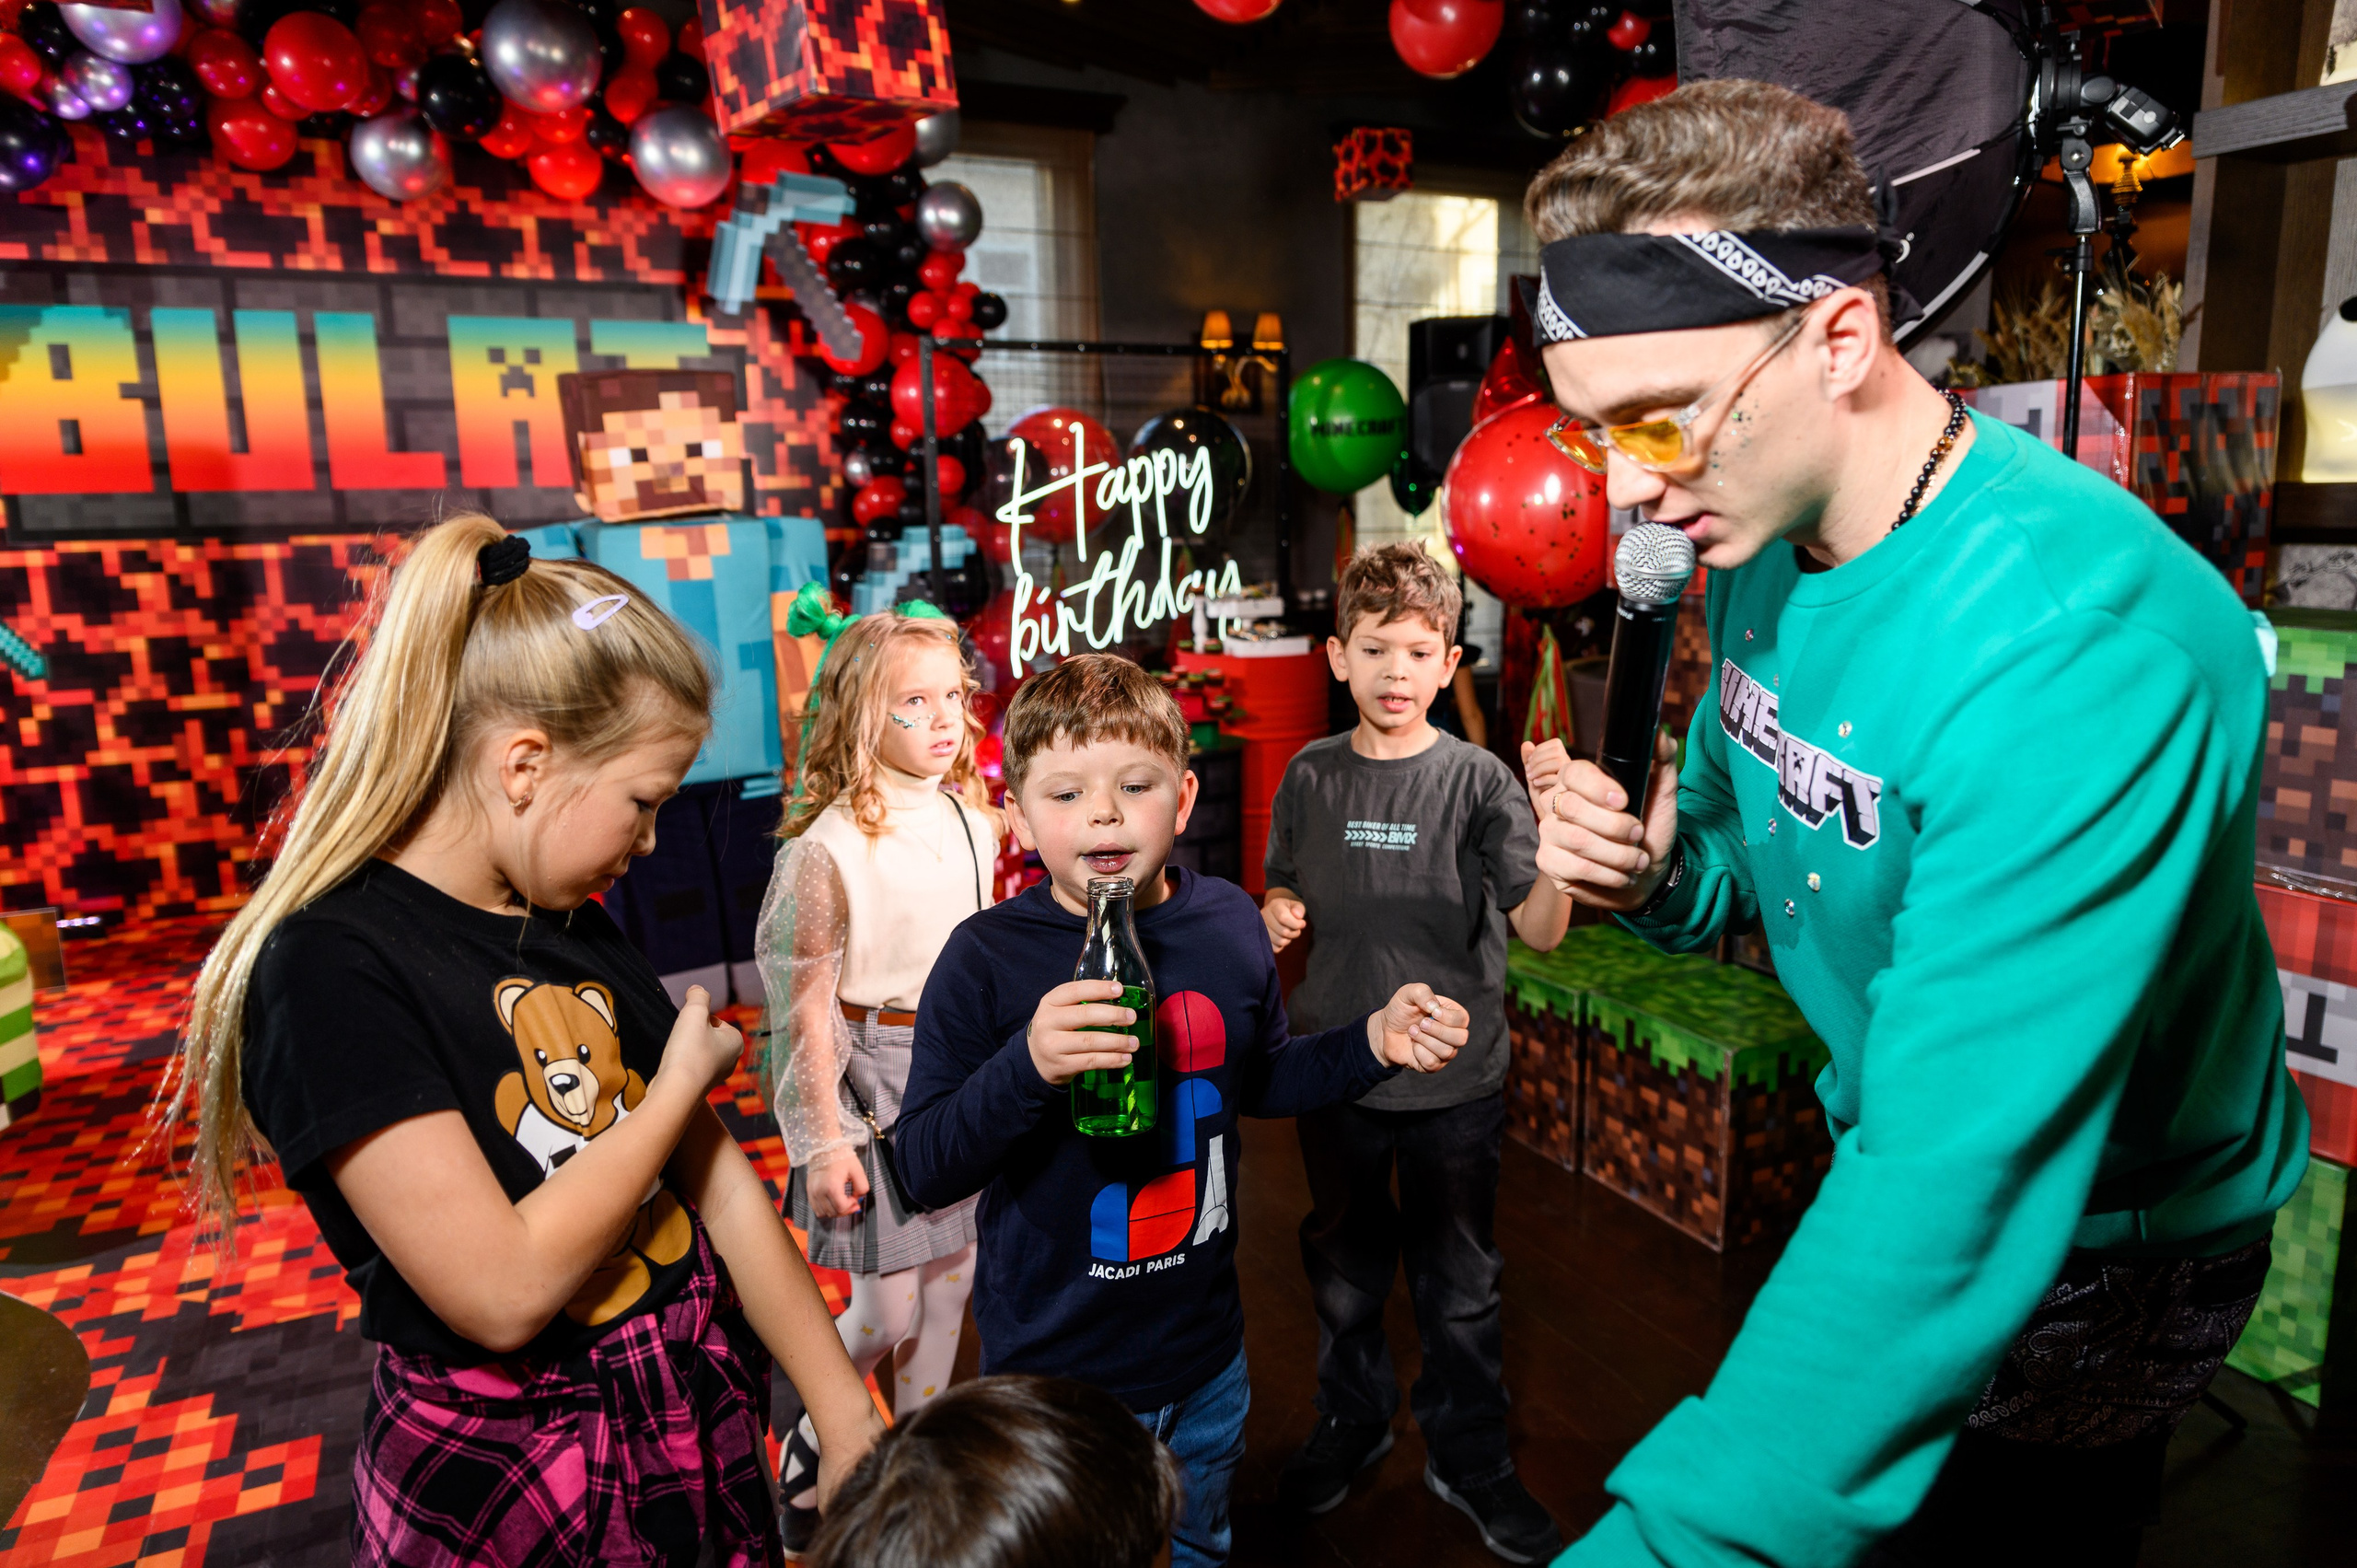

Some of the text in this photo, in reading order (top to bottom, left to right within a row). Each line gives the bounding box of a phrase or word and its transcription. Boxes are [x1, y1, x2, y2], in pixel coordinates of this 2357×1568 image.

[995, 421, 1213, 577] Happy
[1719, 658, 1883, 849] INEAFT
[1347, 820, 1363, 829] BEST
[1401, 824, 1416, 832] TIME
[1387, 831, 1418, 844] BMX
[1088, 1253, 1186, 1280] JACADI PARIS
